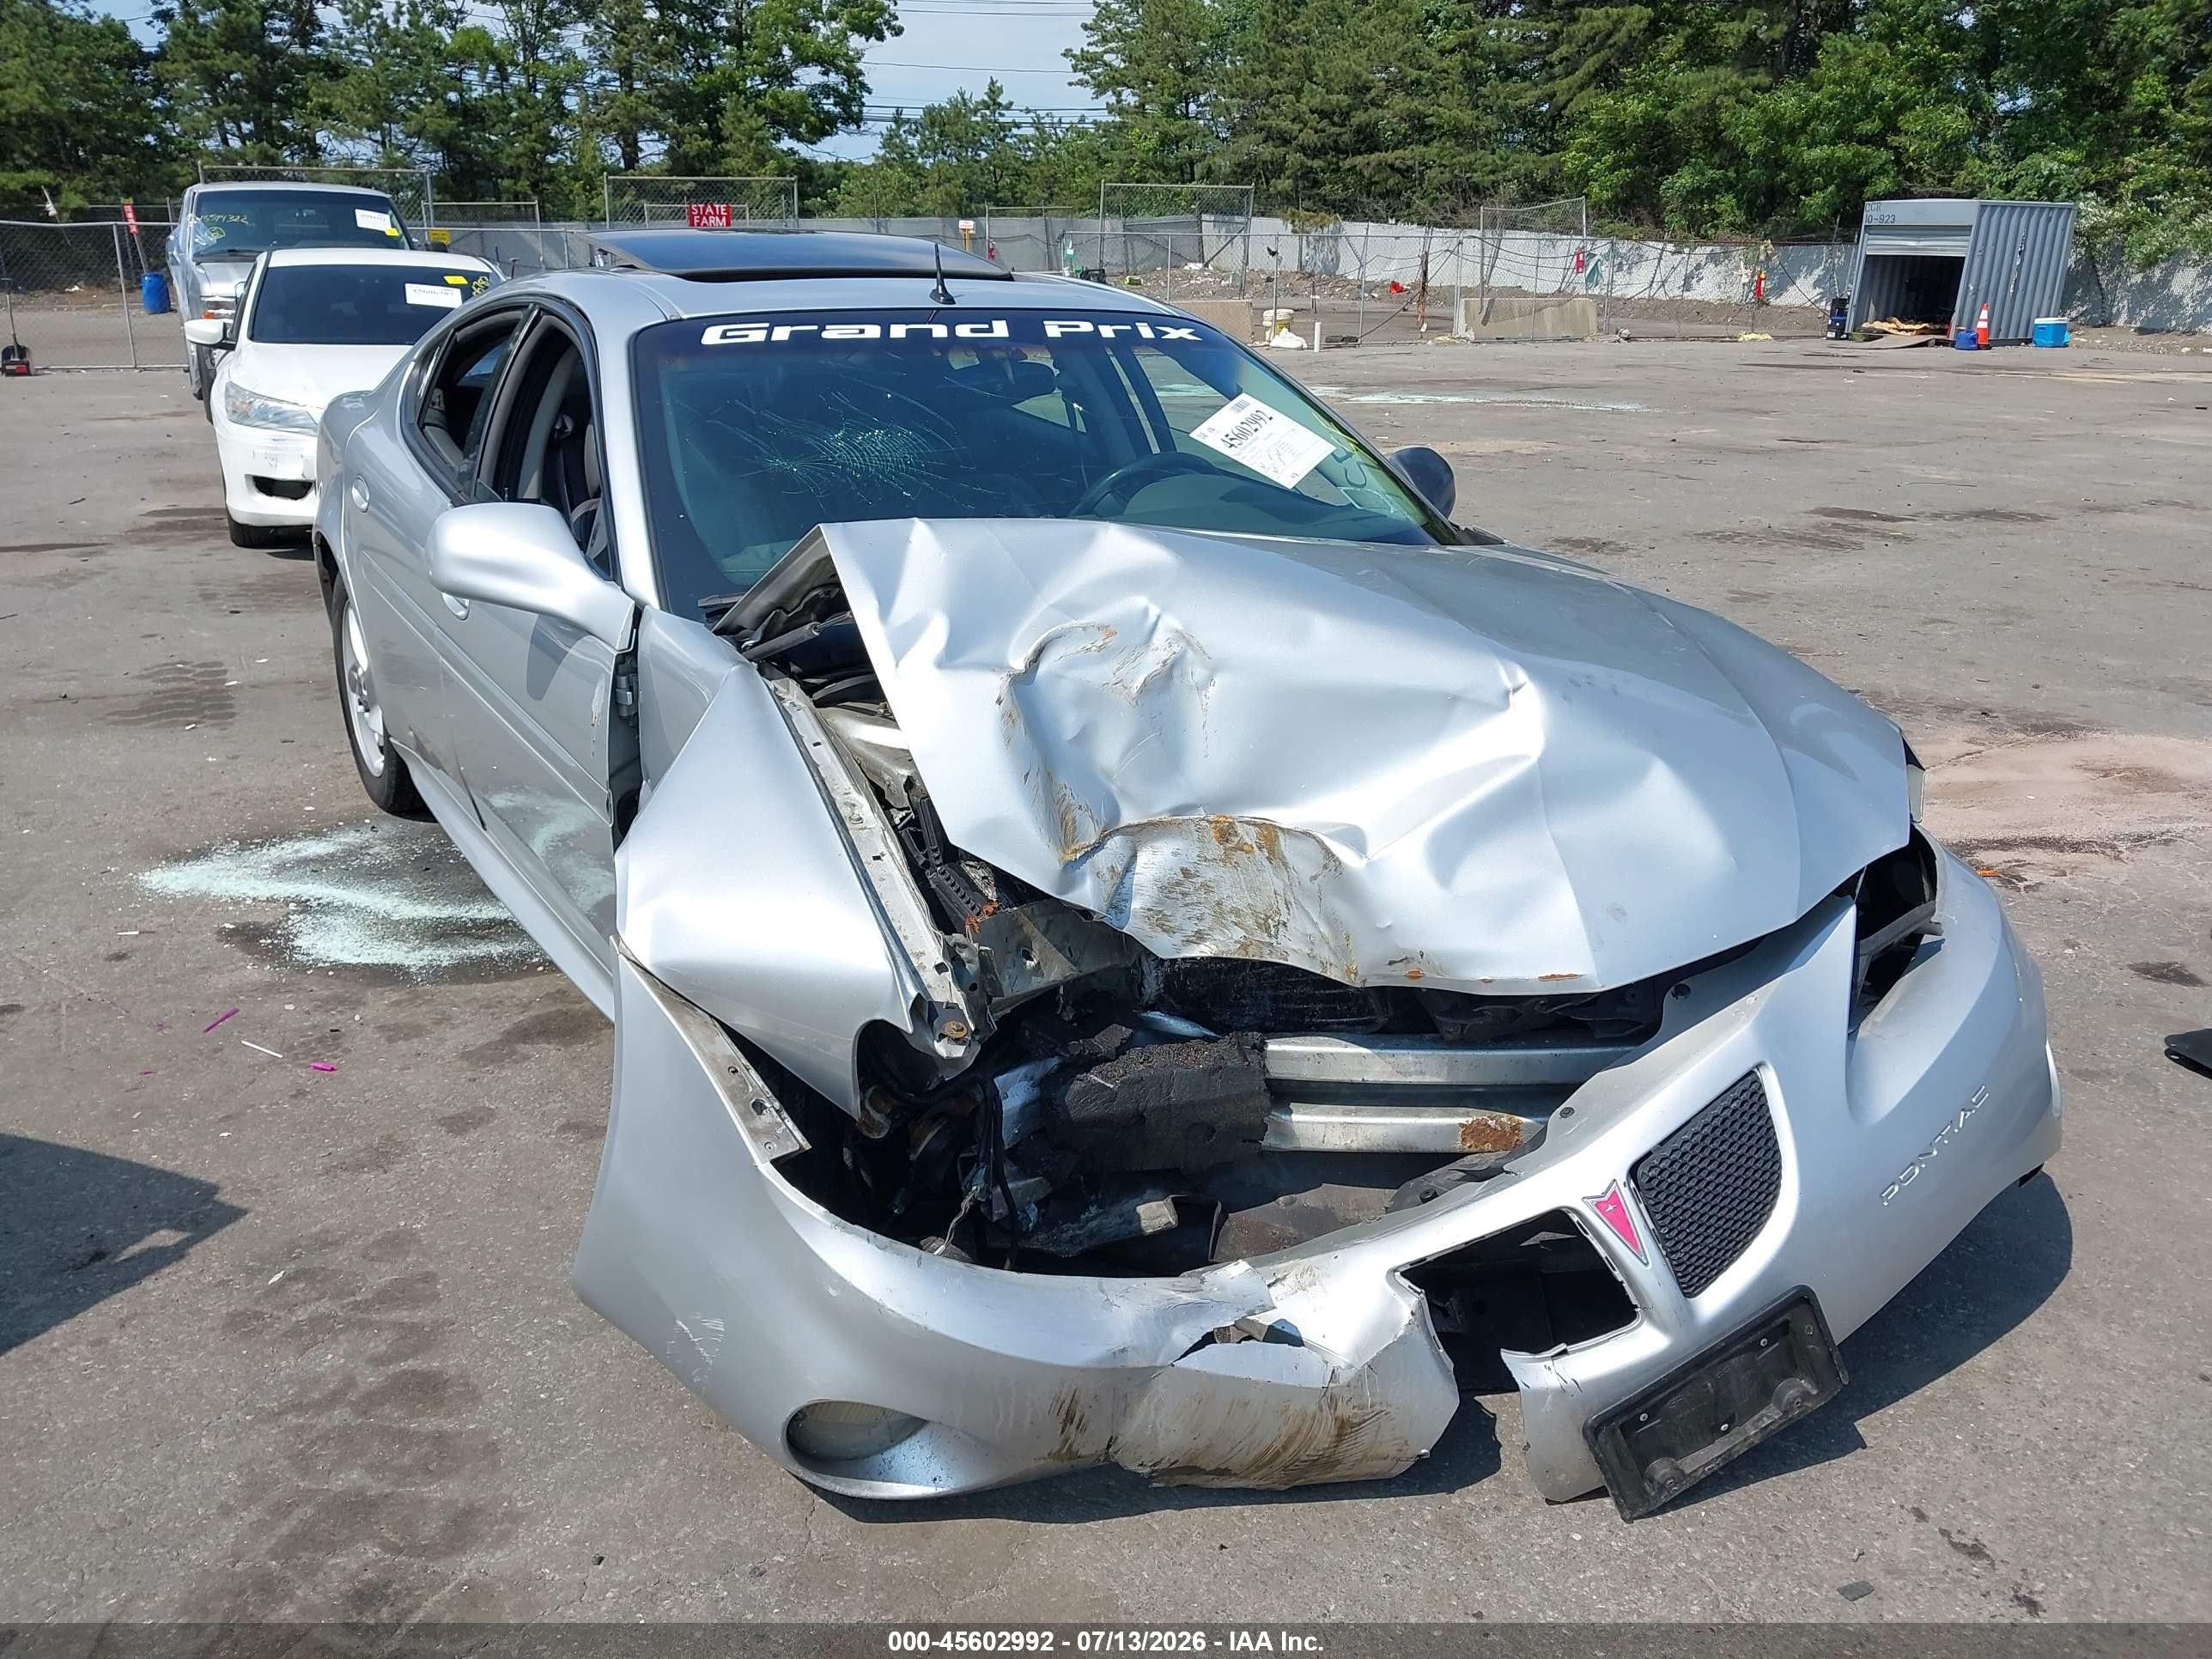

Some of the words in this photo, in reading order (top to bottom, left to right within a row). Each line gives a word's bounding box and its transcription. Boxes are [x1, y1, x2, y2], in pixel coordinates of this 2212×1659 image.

[691, 204, 727, 216] STATE
[694, 216, 726, 228] FARM
[701, 319, 1007, 345] Grand
[1043, 320, 1203, 341] Prix
[1220, 410, 1273, 449] 45602992
[1880, 1085, 1990, 1206] PONTIAC
